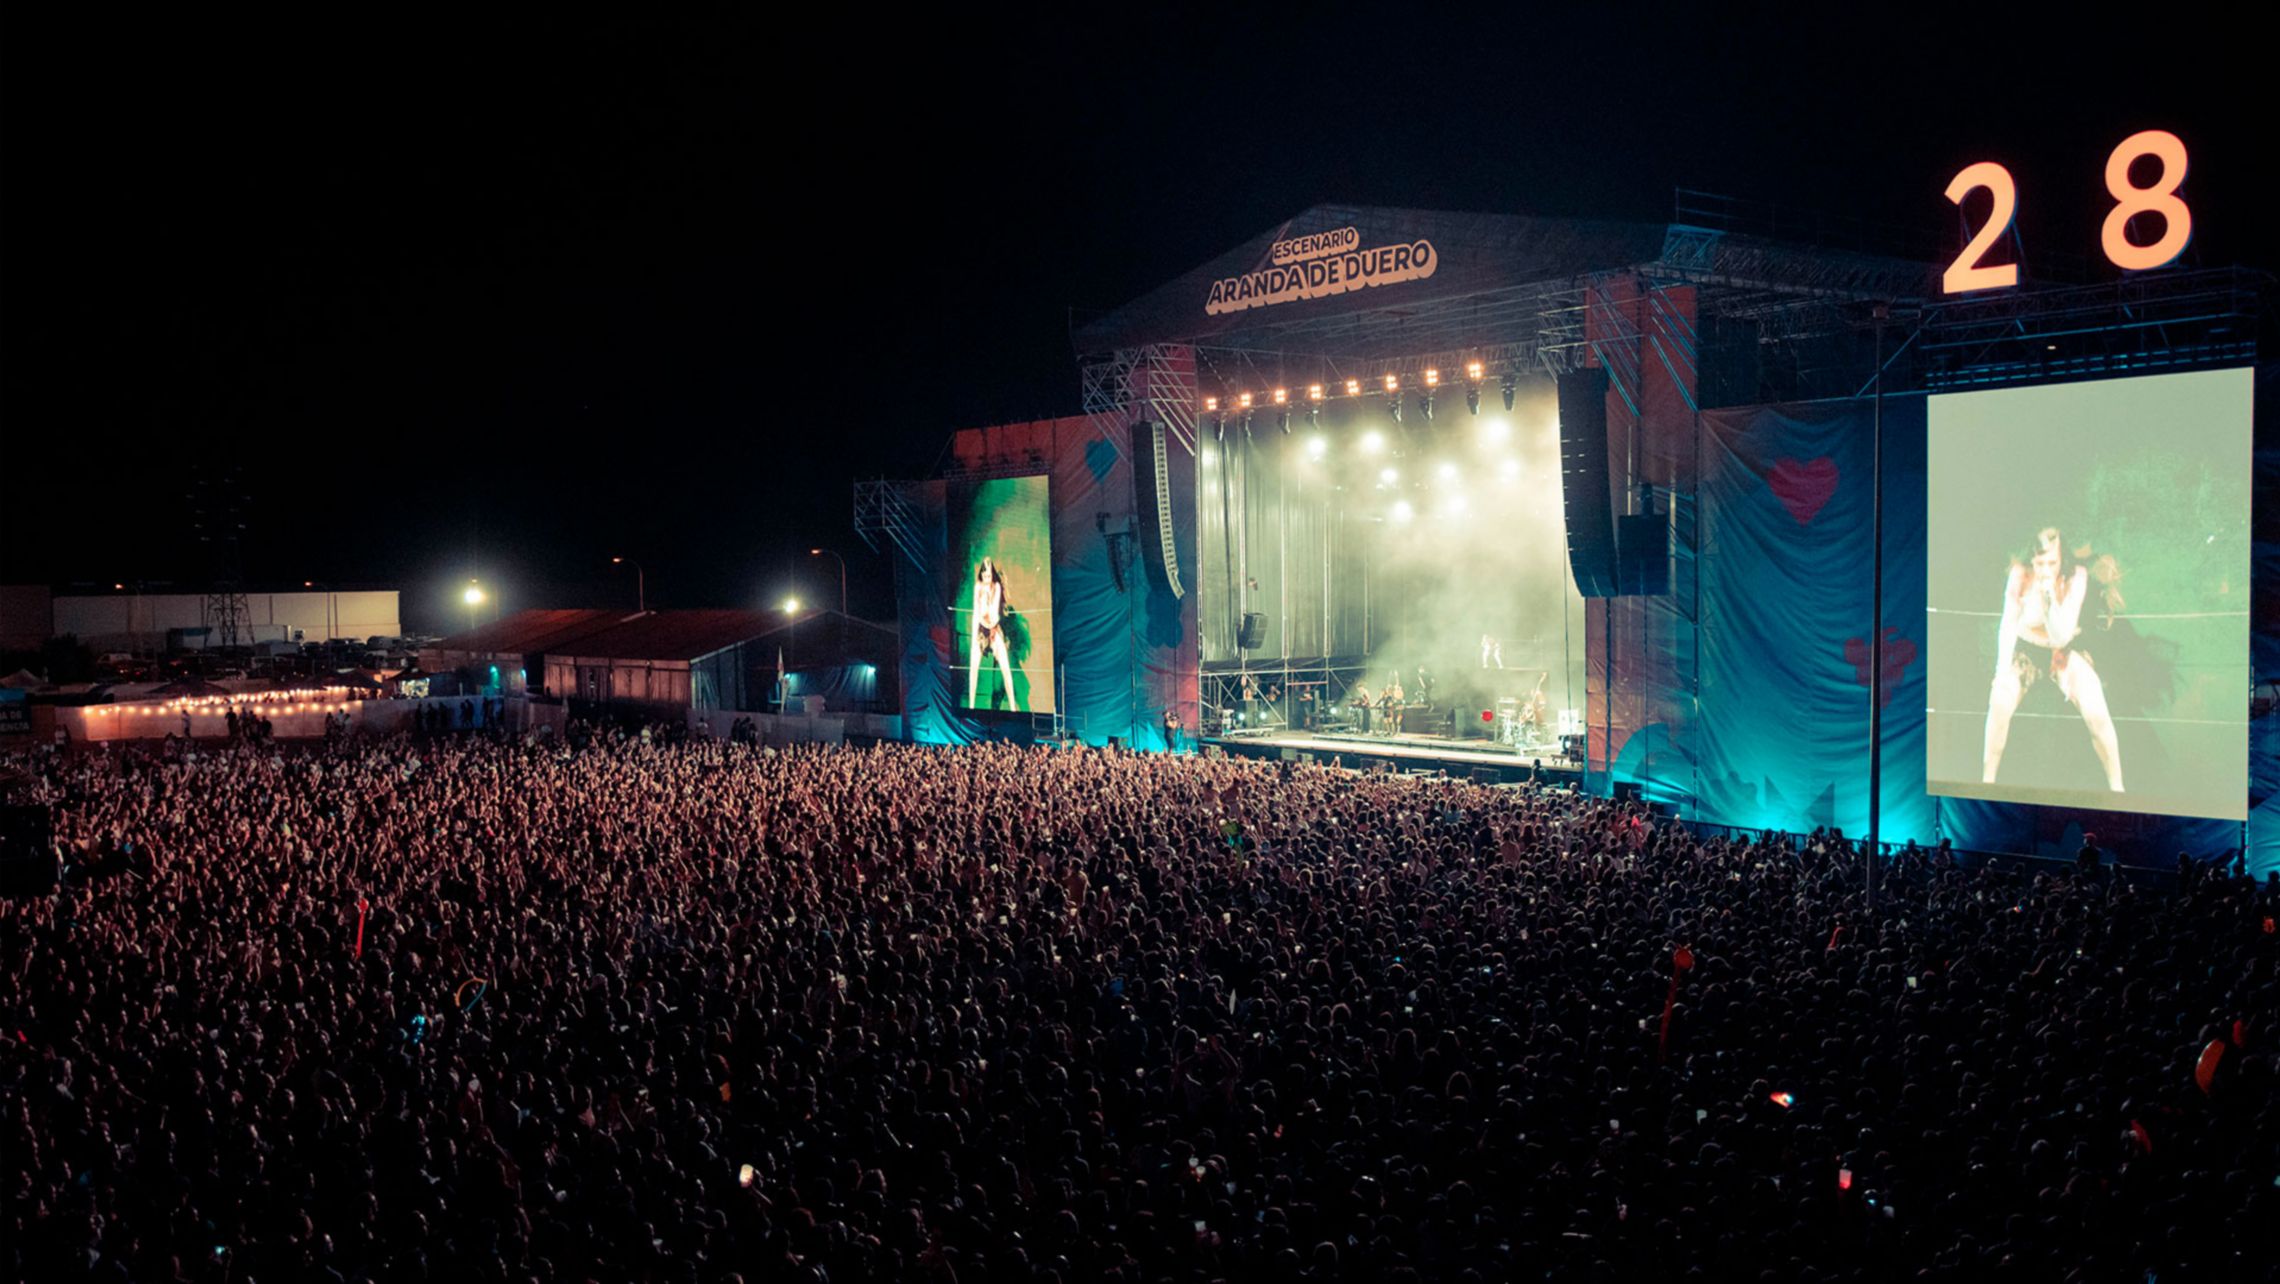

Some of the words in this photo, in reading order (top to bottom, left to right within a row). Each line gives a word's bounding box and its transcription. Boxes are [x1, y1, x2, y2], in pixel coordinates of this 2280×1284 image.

[1273, 228, 1357, 261] ESCENARIO
[1943, 161, 2017, 294] 2
[2101, 130, 2191, 270] 8
[1207, 266, 1304, 309] ARANDA
[1309, 258, 1341, 291] DE
[1345, 241, 1432, 284] DUERO
